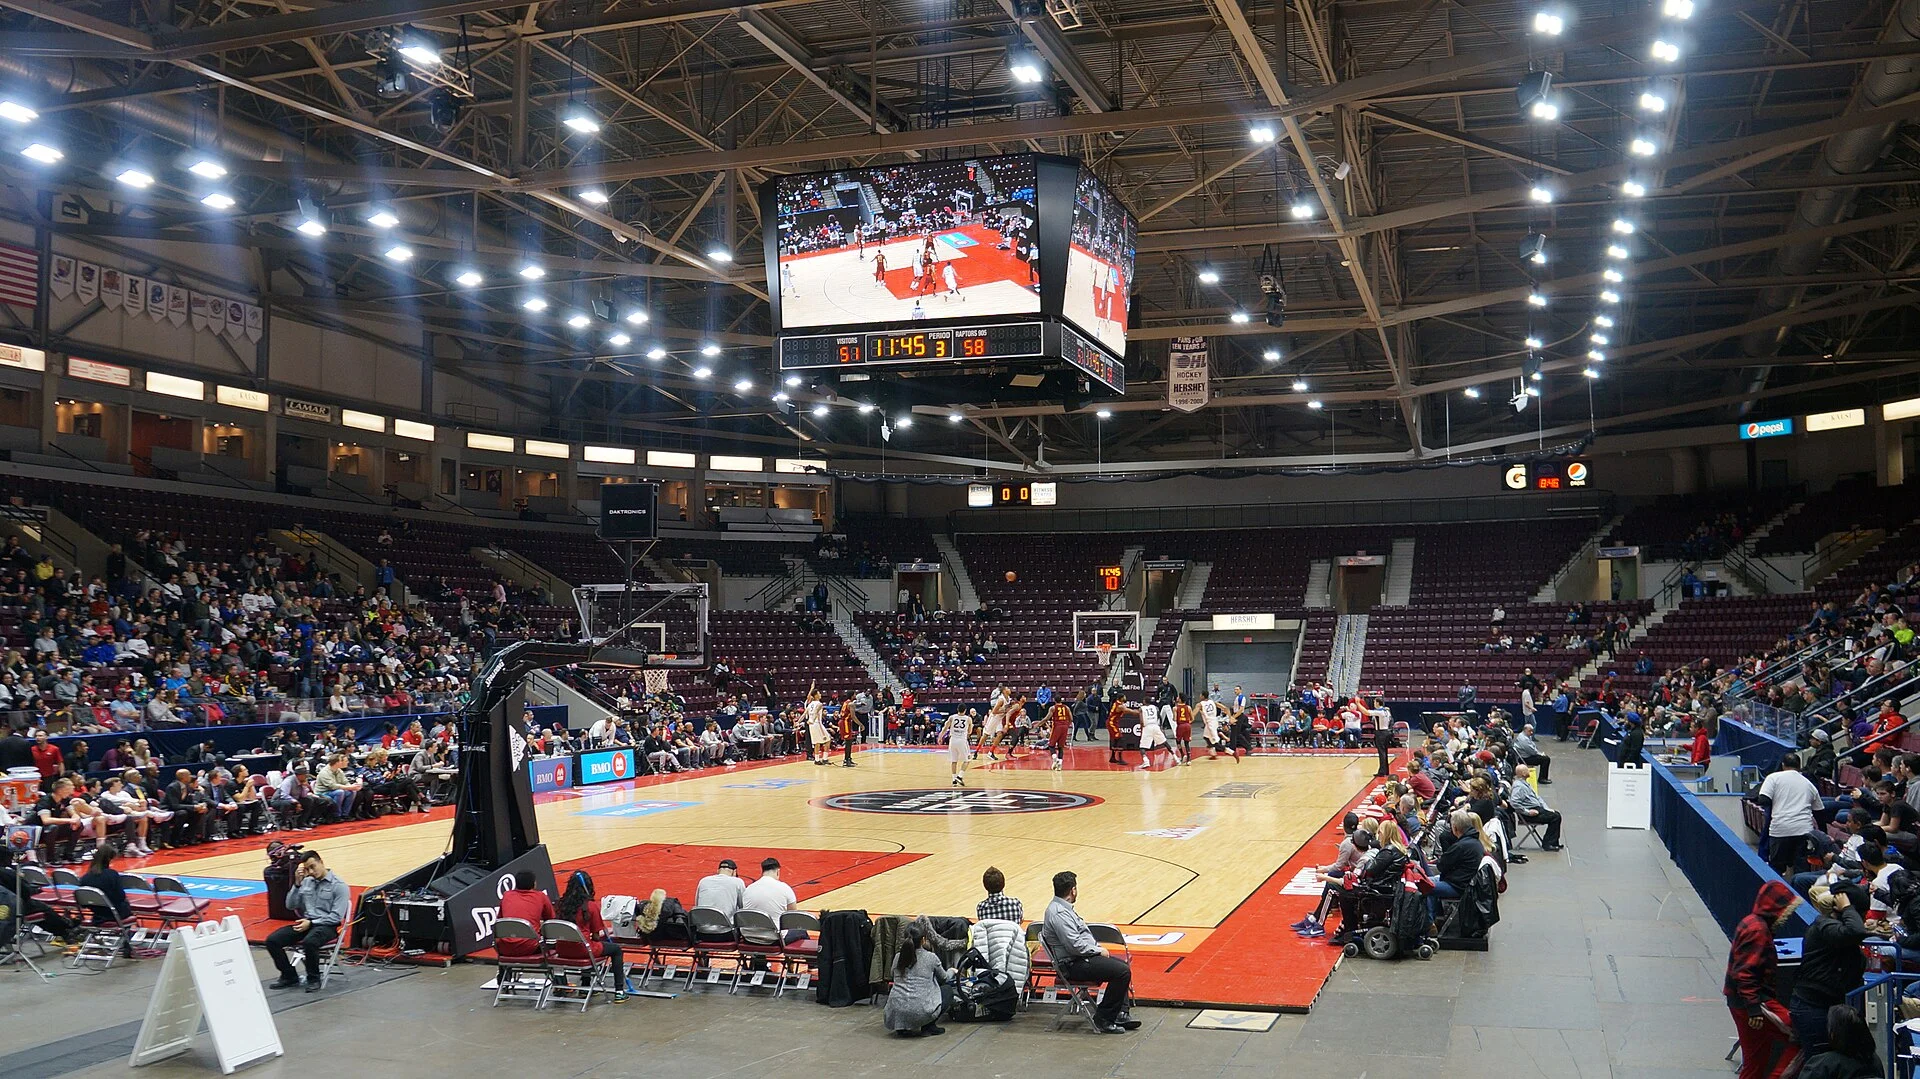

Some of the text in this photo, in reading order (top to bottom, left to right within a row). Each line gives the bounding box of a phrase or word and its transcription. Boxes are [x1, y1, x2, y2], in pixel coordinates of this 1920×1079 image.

[928, 332, 951, 340] PERIOD
[955, 329, 977, 338] RAPTORS
[836, 337, 858, 345] VISITORS
[877, 336, 925, 357] 11:45
[936, 341, 945, 357] 3
[964, 339, 984, 355] 58
[1182, 343, 1200, 351] YEARS
[840, 346, 860, 362] 51
[1176, 371, 1203, 379] HOCKEY
[1173, 382, 1206, 393] HERSHEY
[289, 401, 327, 415] LAMAR
[1759, 422, 1784, 436] pepsi
[1002, 487, 1010, 501] 0
[1020, 487, 1029, 500] 0
[1106, 576, 1118, 590] 10
[1230, 615, 1258, 624] HERSHEY
[1057, 707, 1066, 717] 21
[1145, 708, 1155, 717] 13
[1180, 708, 1185, 717] 2
[1205, 703, 1214, 713] 20
[953, 718, 966, 729] 23
[590, 762, 611, 775] BMO
[536, 773, 553, 784] BMO
